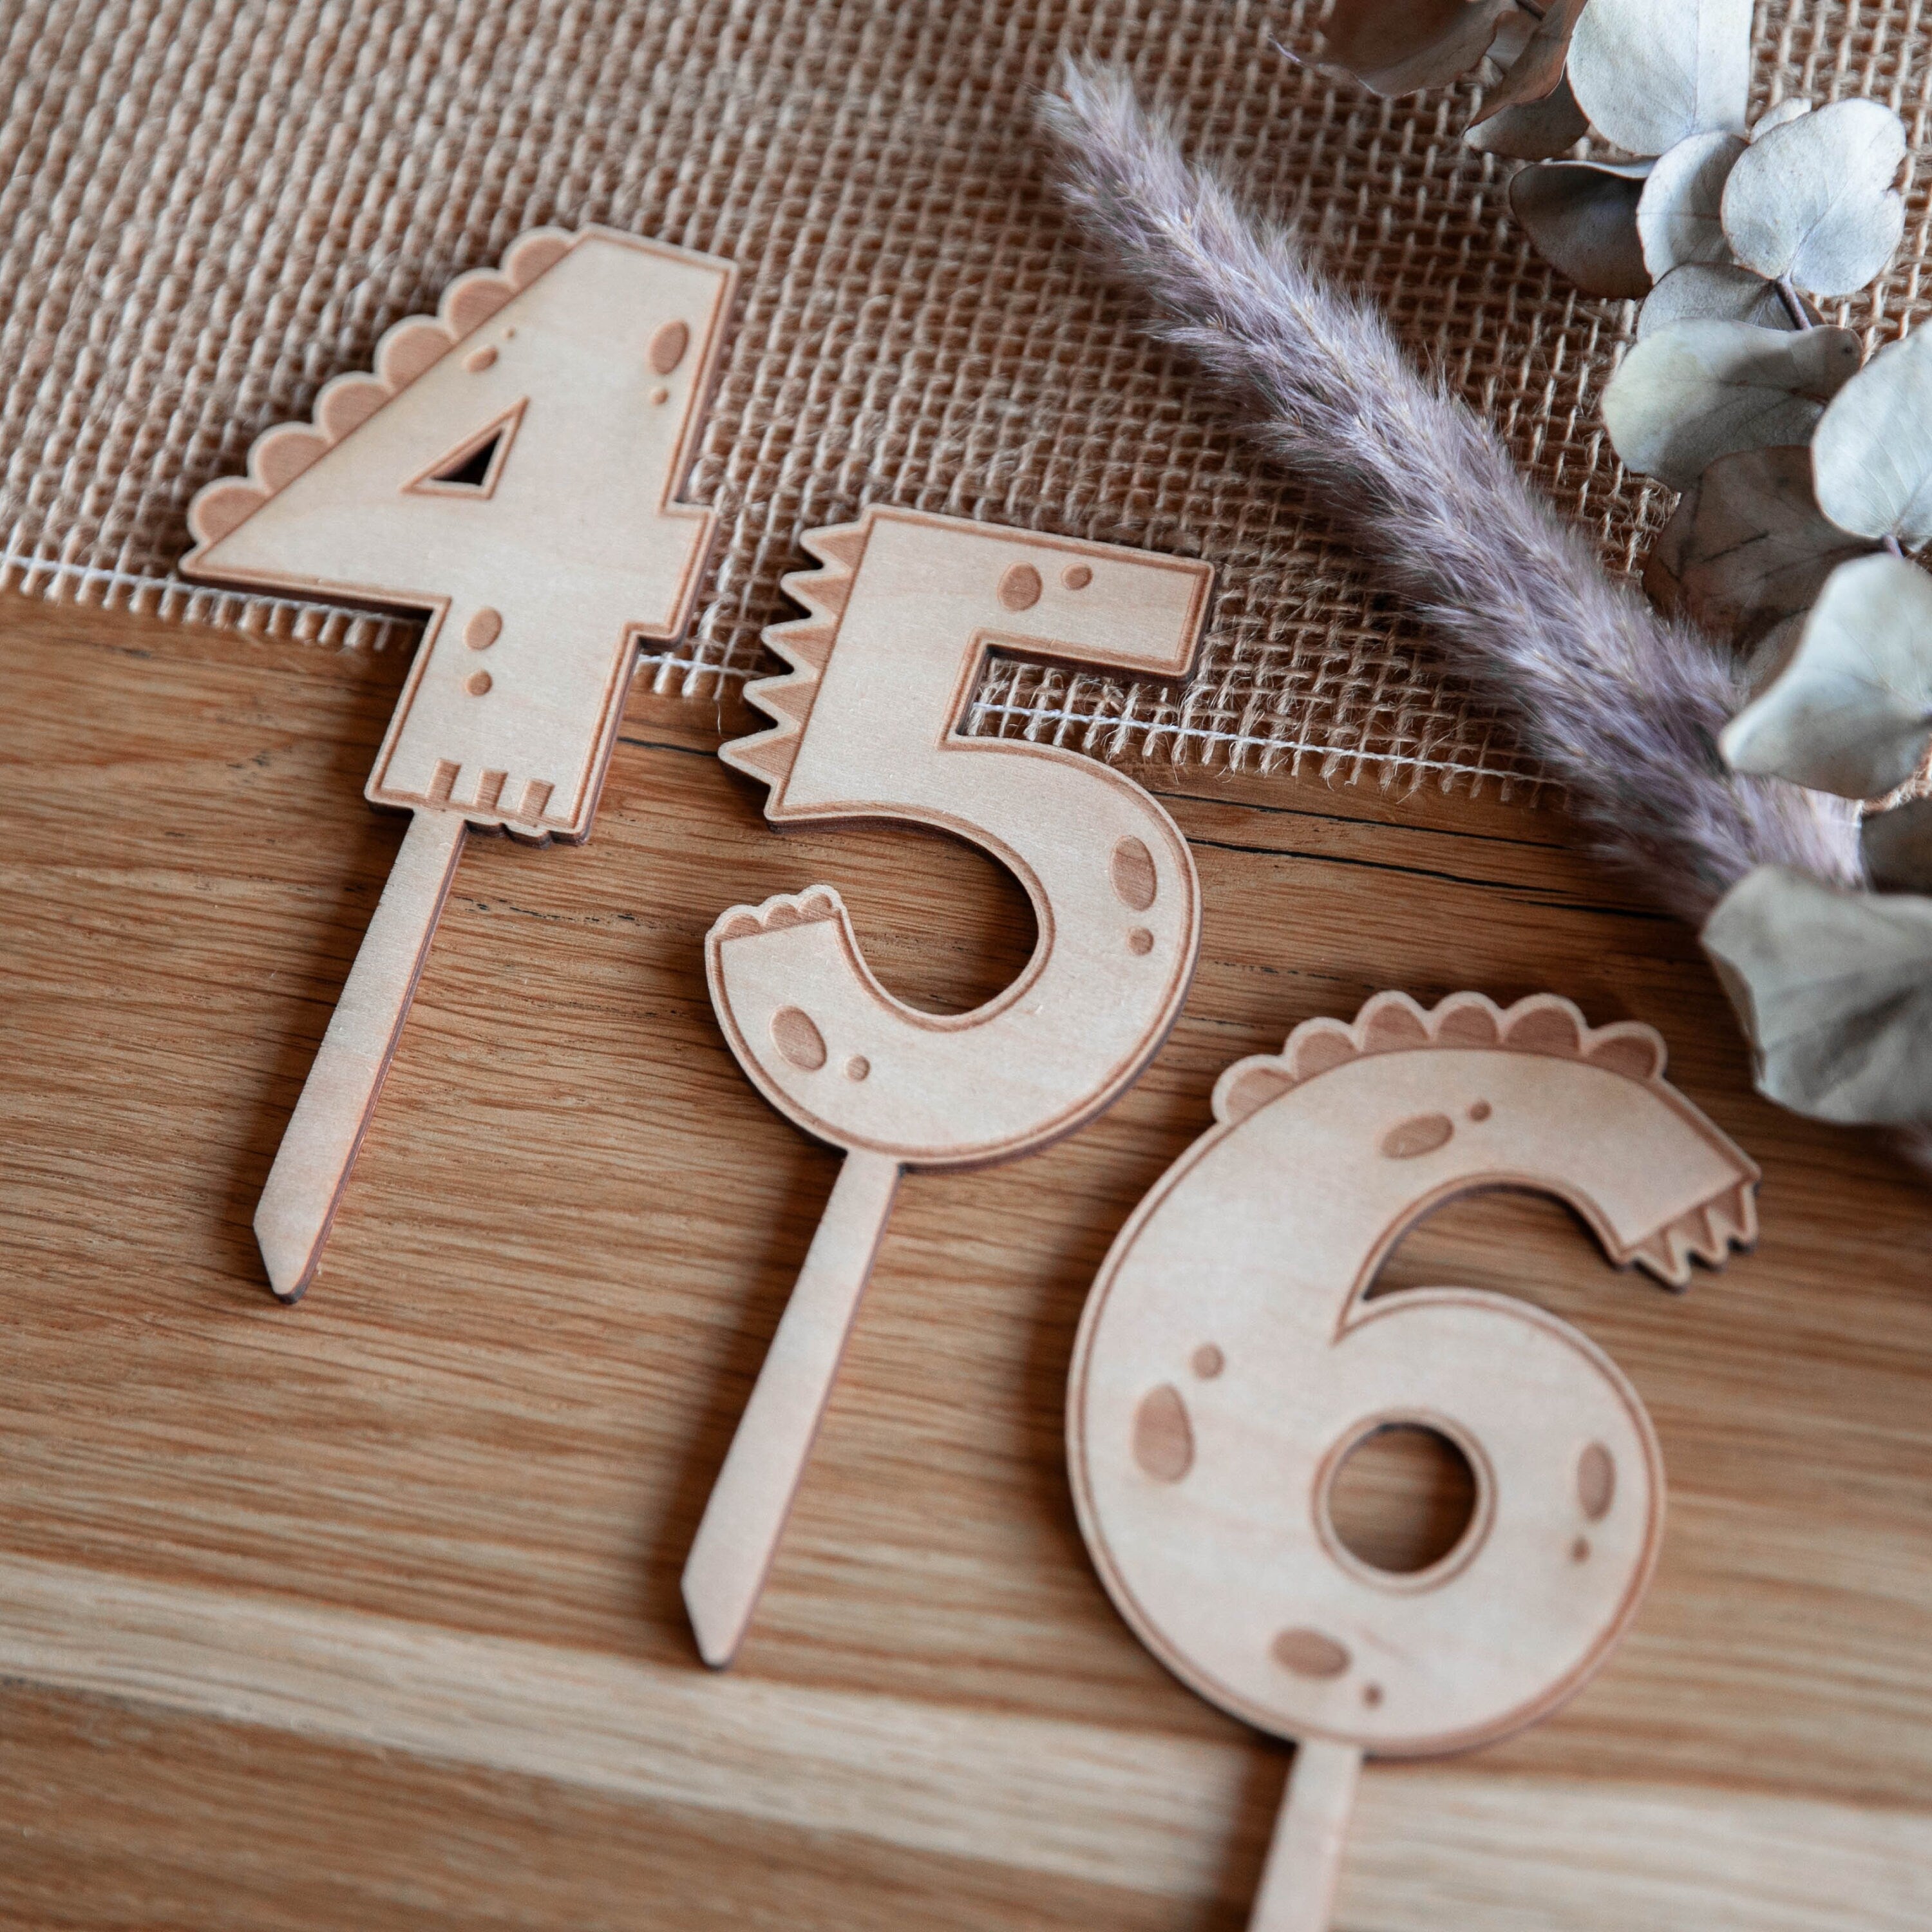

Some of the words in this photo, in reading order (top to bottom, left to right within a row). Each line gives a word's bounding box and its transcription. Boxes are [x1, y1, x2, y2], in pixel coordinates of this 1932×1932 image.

[180, 223, 739, 845] 4
[705, 504, 1216, 1167] 5
[1065, 990, 1761, 1757] 6
